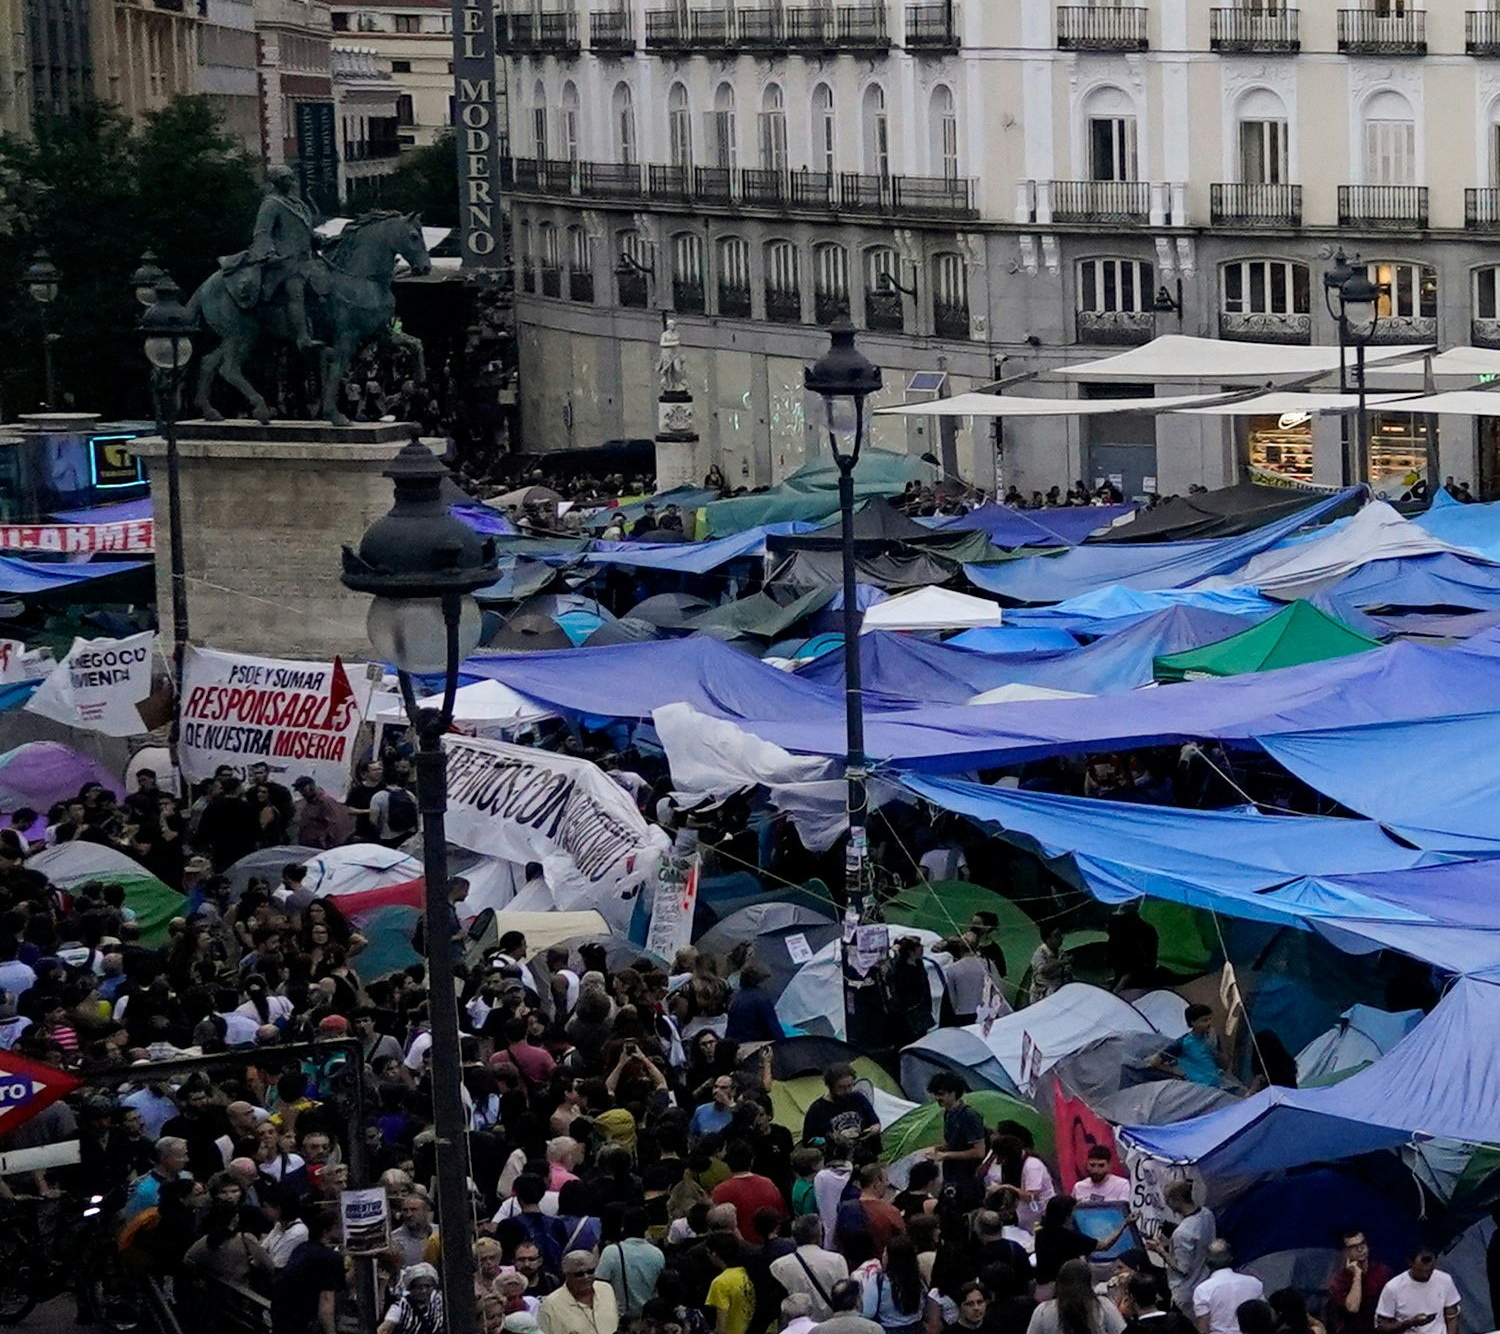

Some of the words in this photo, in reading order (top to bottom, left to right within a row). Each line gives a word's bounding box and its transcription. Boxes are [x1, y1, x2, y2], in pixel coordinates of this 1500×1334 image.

[458, 78, 494, 256] MODERNO
[272, 668, 326, 692] SUMAR
[204, 724, 274, 756] NUESTRA
[272, 730, 347, 762] MISERIA
